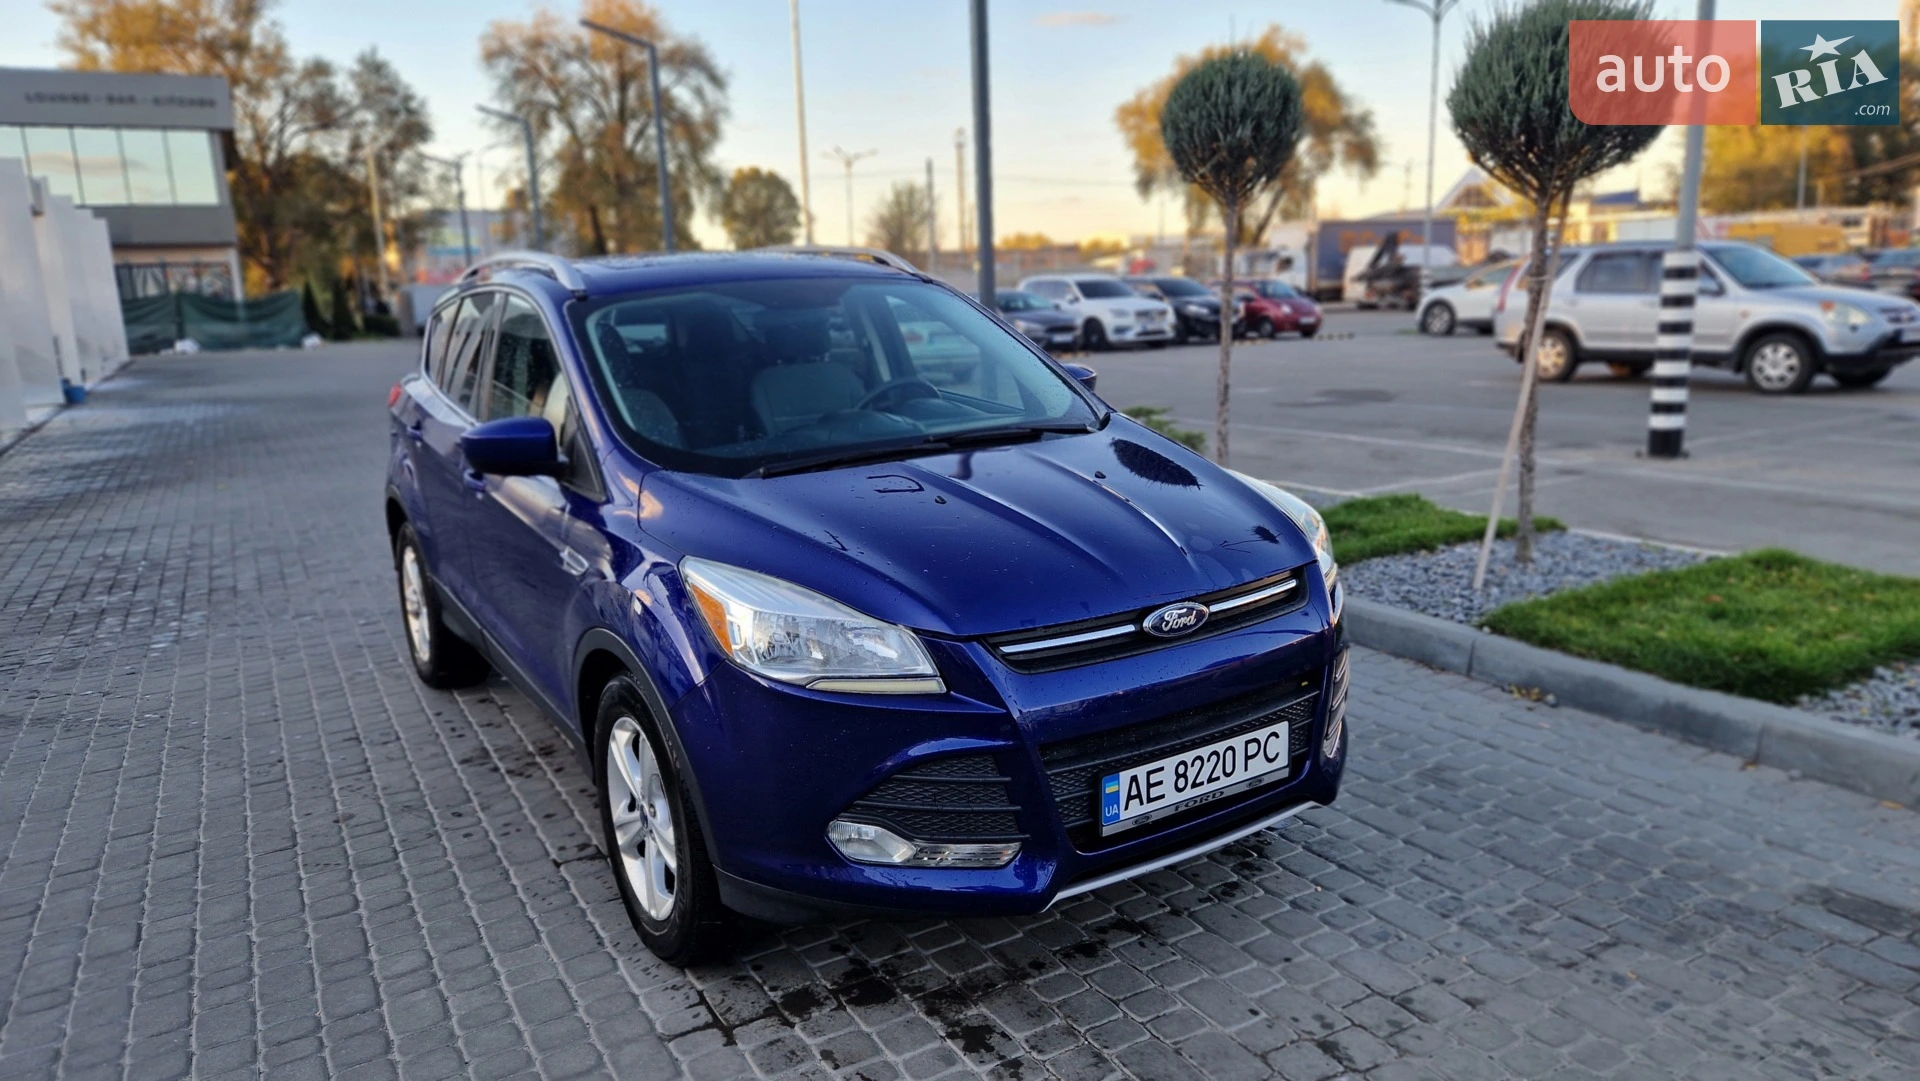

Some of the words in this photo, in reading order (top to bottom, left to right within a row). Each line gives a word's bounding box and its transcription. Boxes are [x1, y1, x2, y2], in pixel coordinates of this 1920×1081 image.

[1162, 608, 1197, 631] Ford
[1124, 766, 1165, 811] AE
[1174, 745, 1236, 794] 8220
[1244, 731, 1280, 772] PC
[1105, 804, 1119, 817] UA
[1174, 790, 1225, 812] FORD
